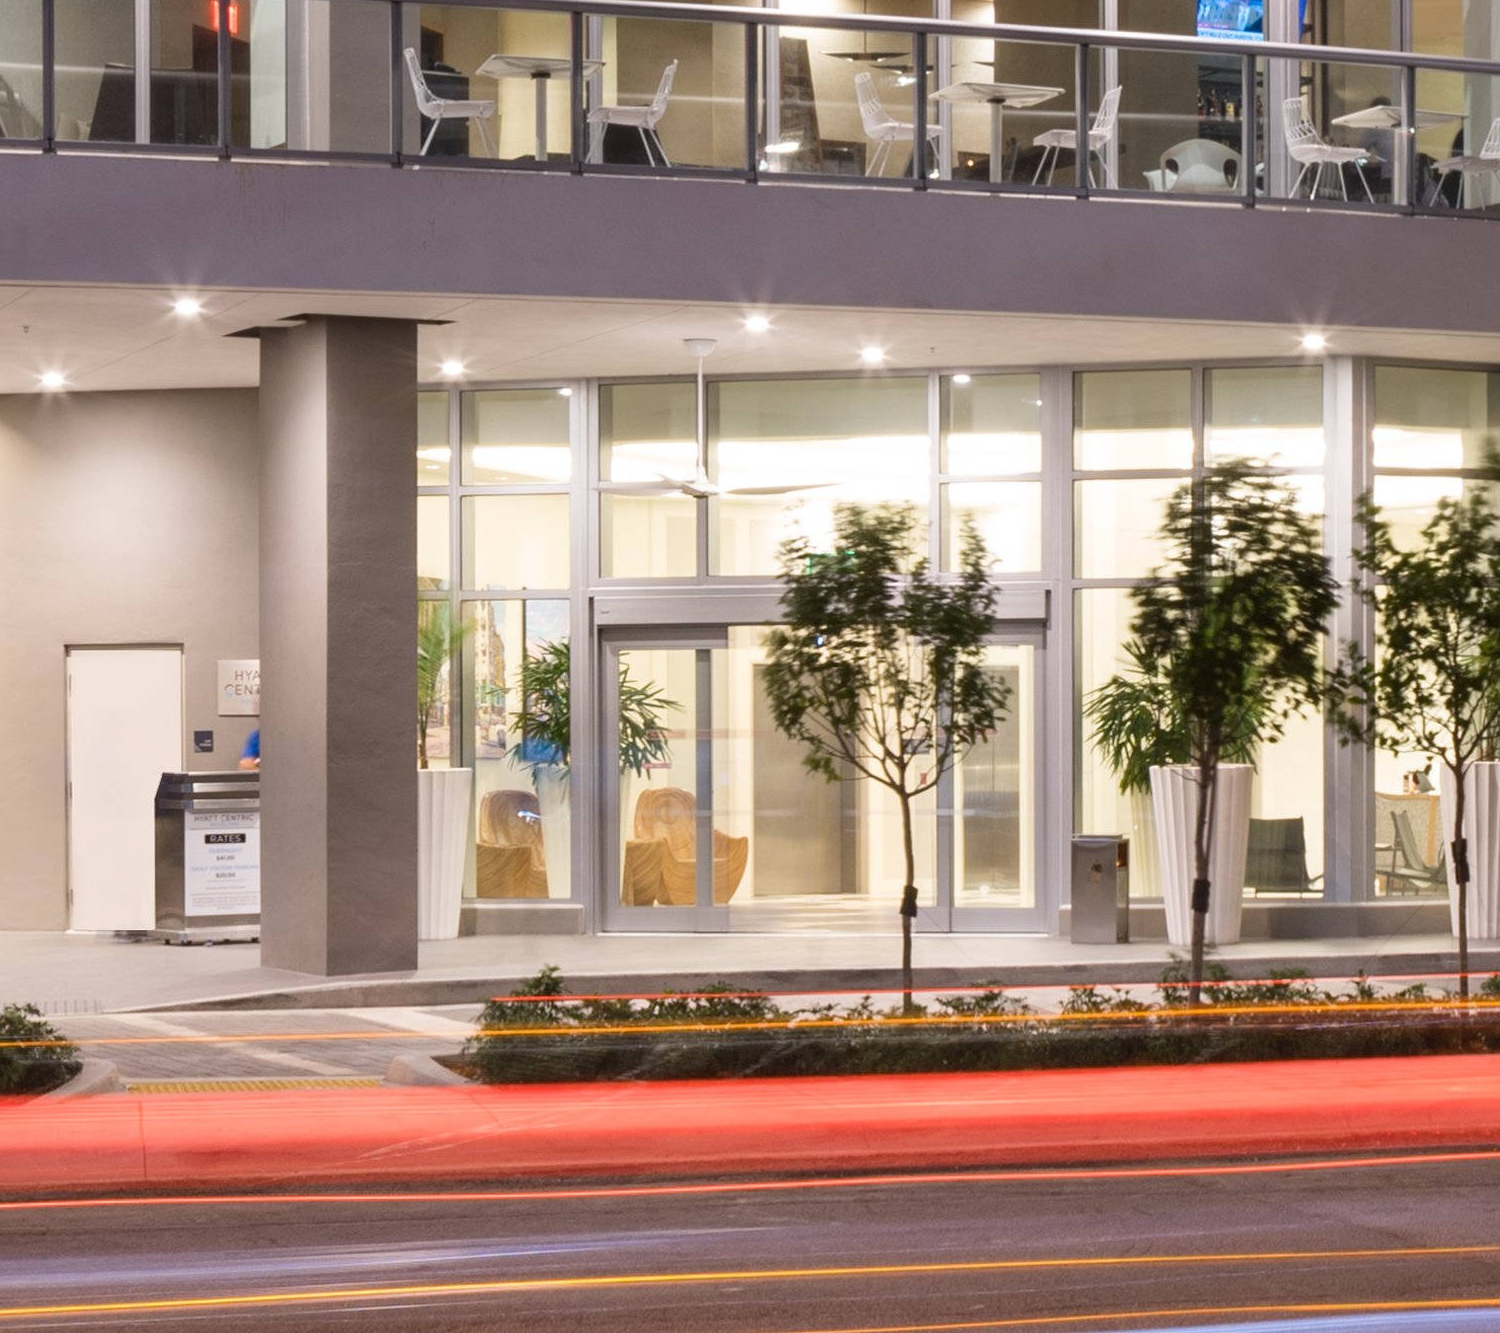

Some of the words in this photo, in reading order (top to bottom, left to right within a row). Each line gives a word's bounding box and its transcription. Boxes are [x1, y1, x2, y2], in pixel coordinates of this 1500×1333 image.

[234, 670, 260, 681] HYA
[224, 684, 260, 697] CENT
[194, 814, 218, 822] HYATT
[220, 813, 255, 823] CENTRIC
[209, 834, 242, 843] RATES
